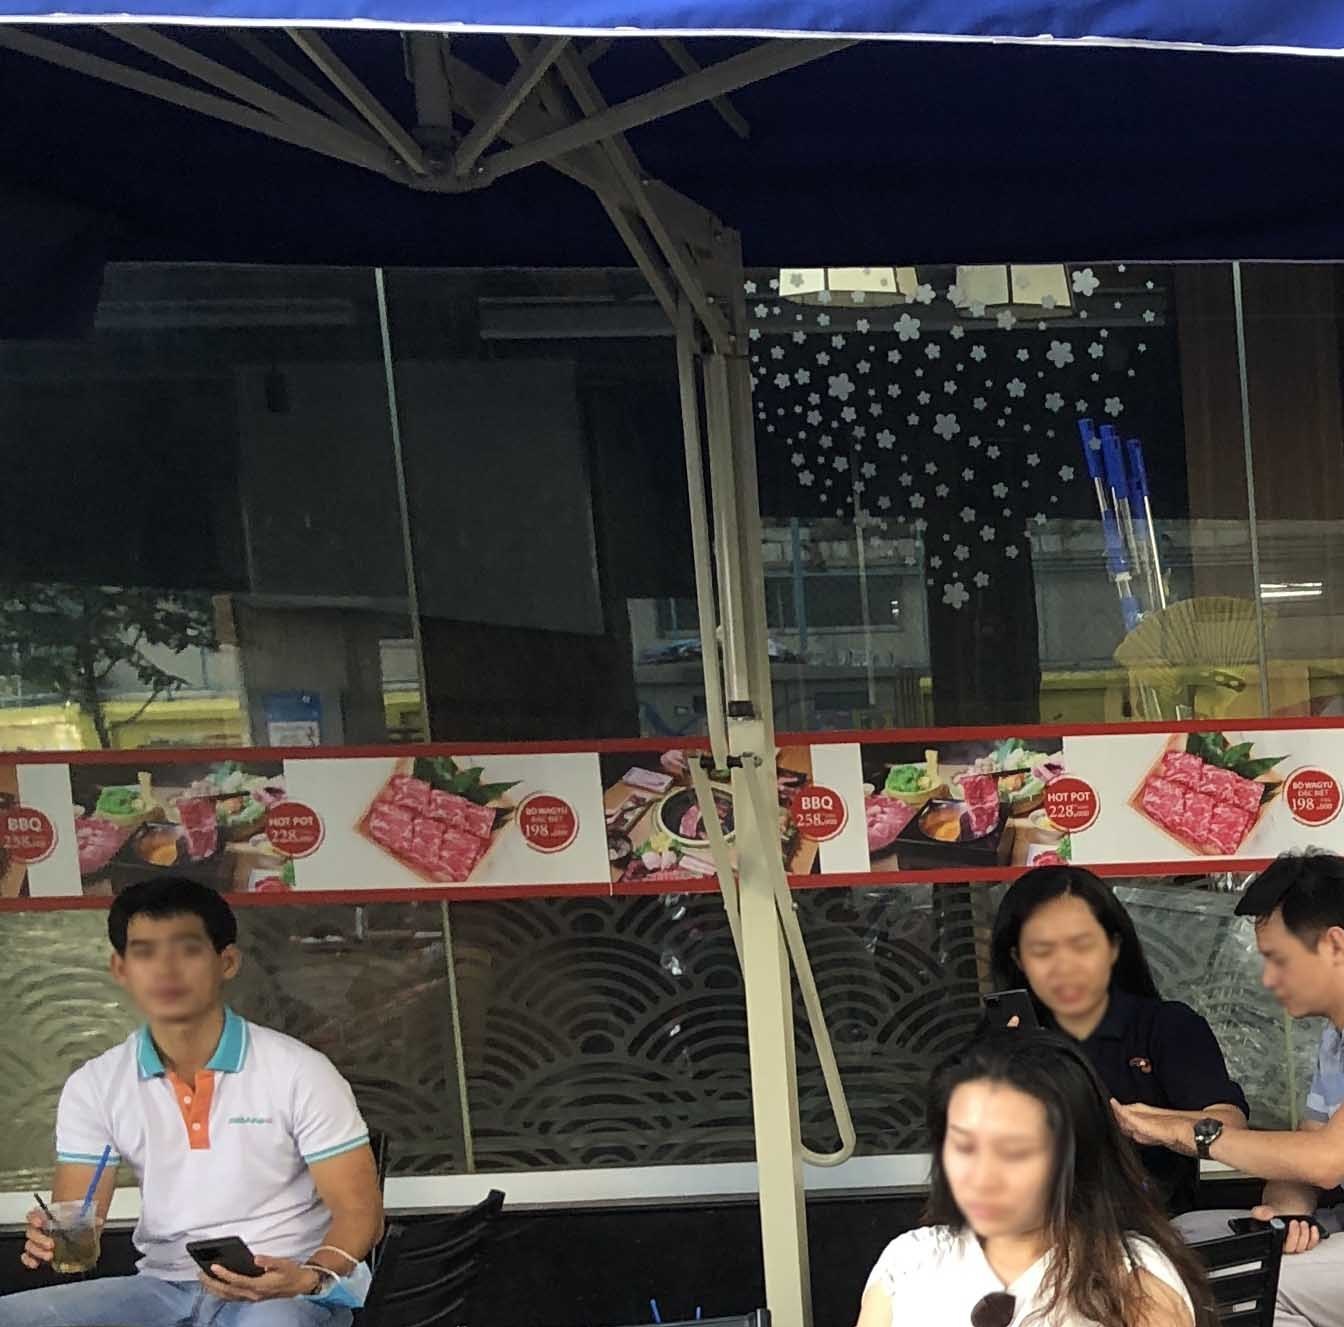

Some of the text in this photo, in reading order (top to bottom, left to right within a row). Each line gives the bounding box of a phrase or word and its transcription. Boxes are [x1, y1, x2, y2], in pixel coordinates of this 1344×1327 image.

[1047, 791, 1091, 802] HOT POT
[801, 796, 833, 810] BBQ
[7, 817, 42, 832] BBQ
[269, 815, 313, 826] HOT POT
